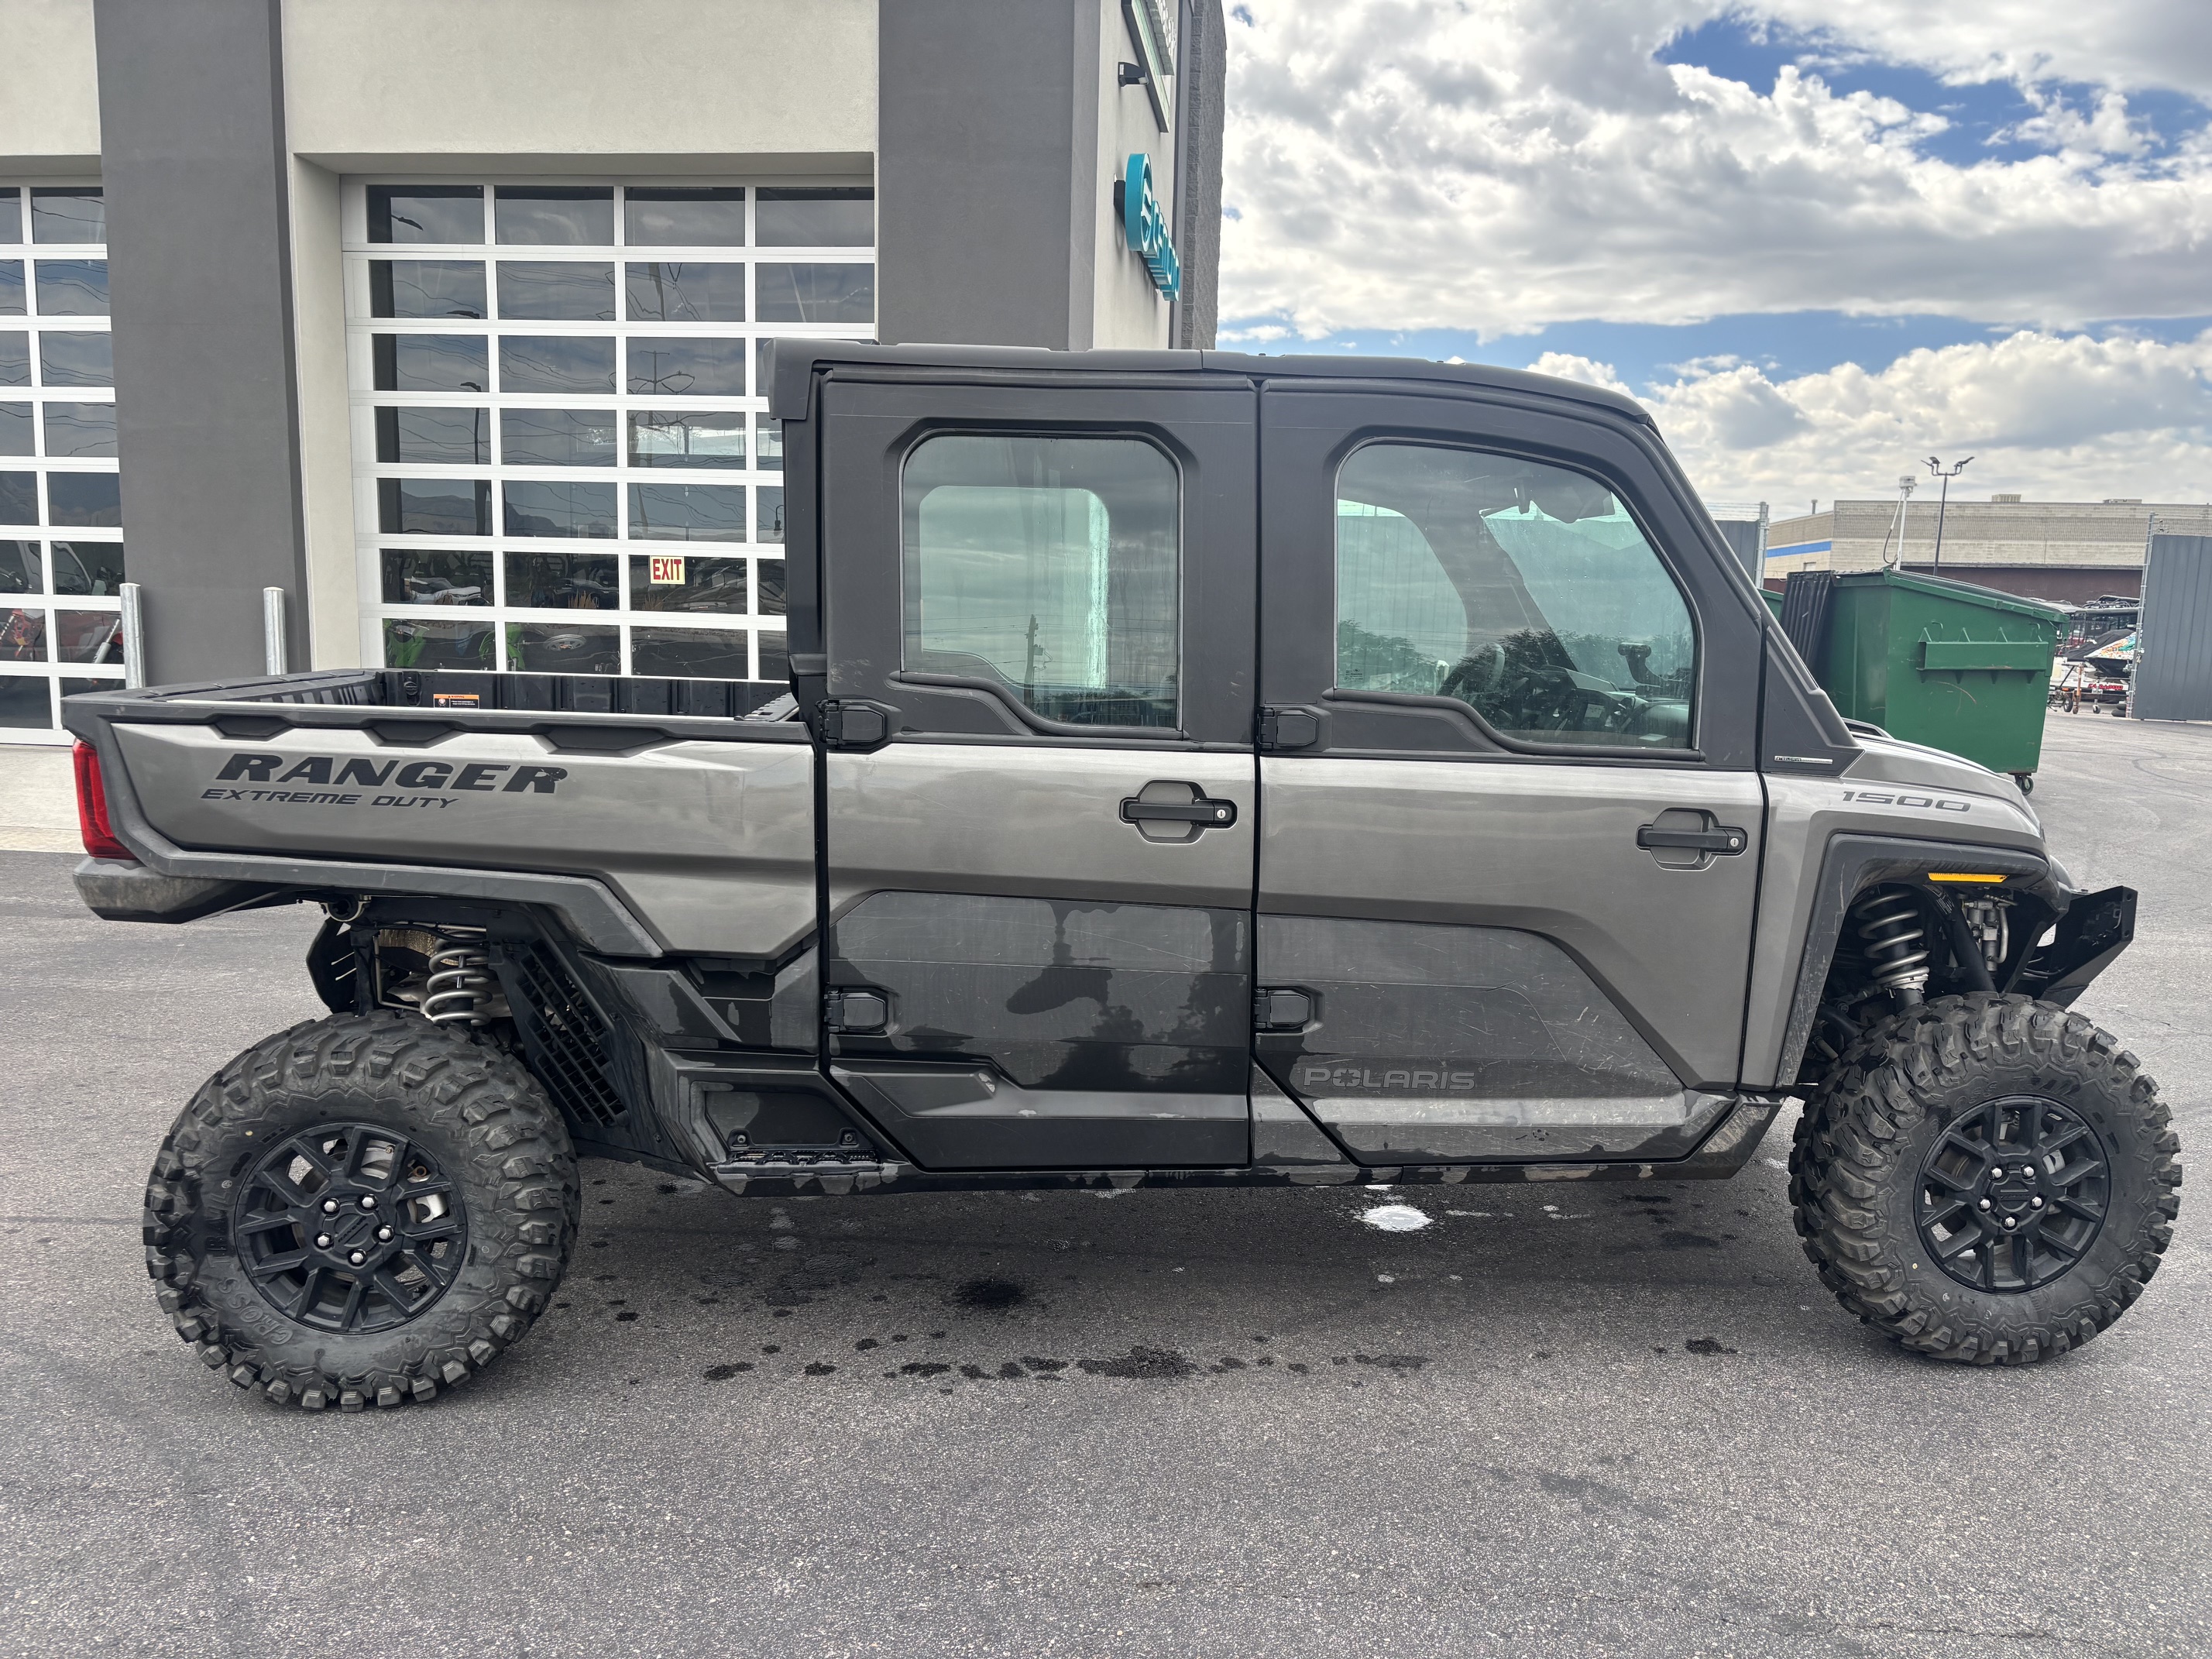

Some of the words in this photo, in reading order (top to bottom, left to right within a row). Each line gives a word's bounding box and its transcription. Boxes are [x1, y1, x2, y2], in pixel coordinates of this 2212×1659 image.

[652, 558, 682, 581] EXIT
[215, 753, 568, 794] RANGER
[201, 788, 362, 805] EXTREME
[371, 795, 459, 809] DUTY
[1843, 791, 1971, 812] 1500
[1304, 1067, 1475, 1091] POLARIS
[205, 1192, 233, 1269] TRAIL
[217, 1278, 294, 1345] CROSS
